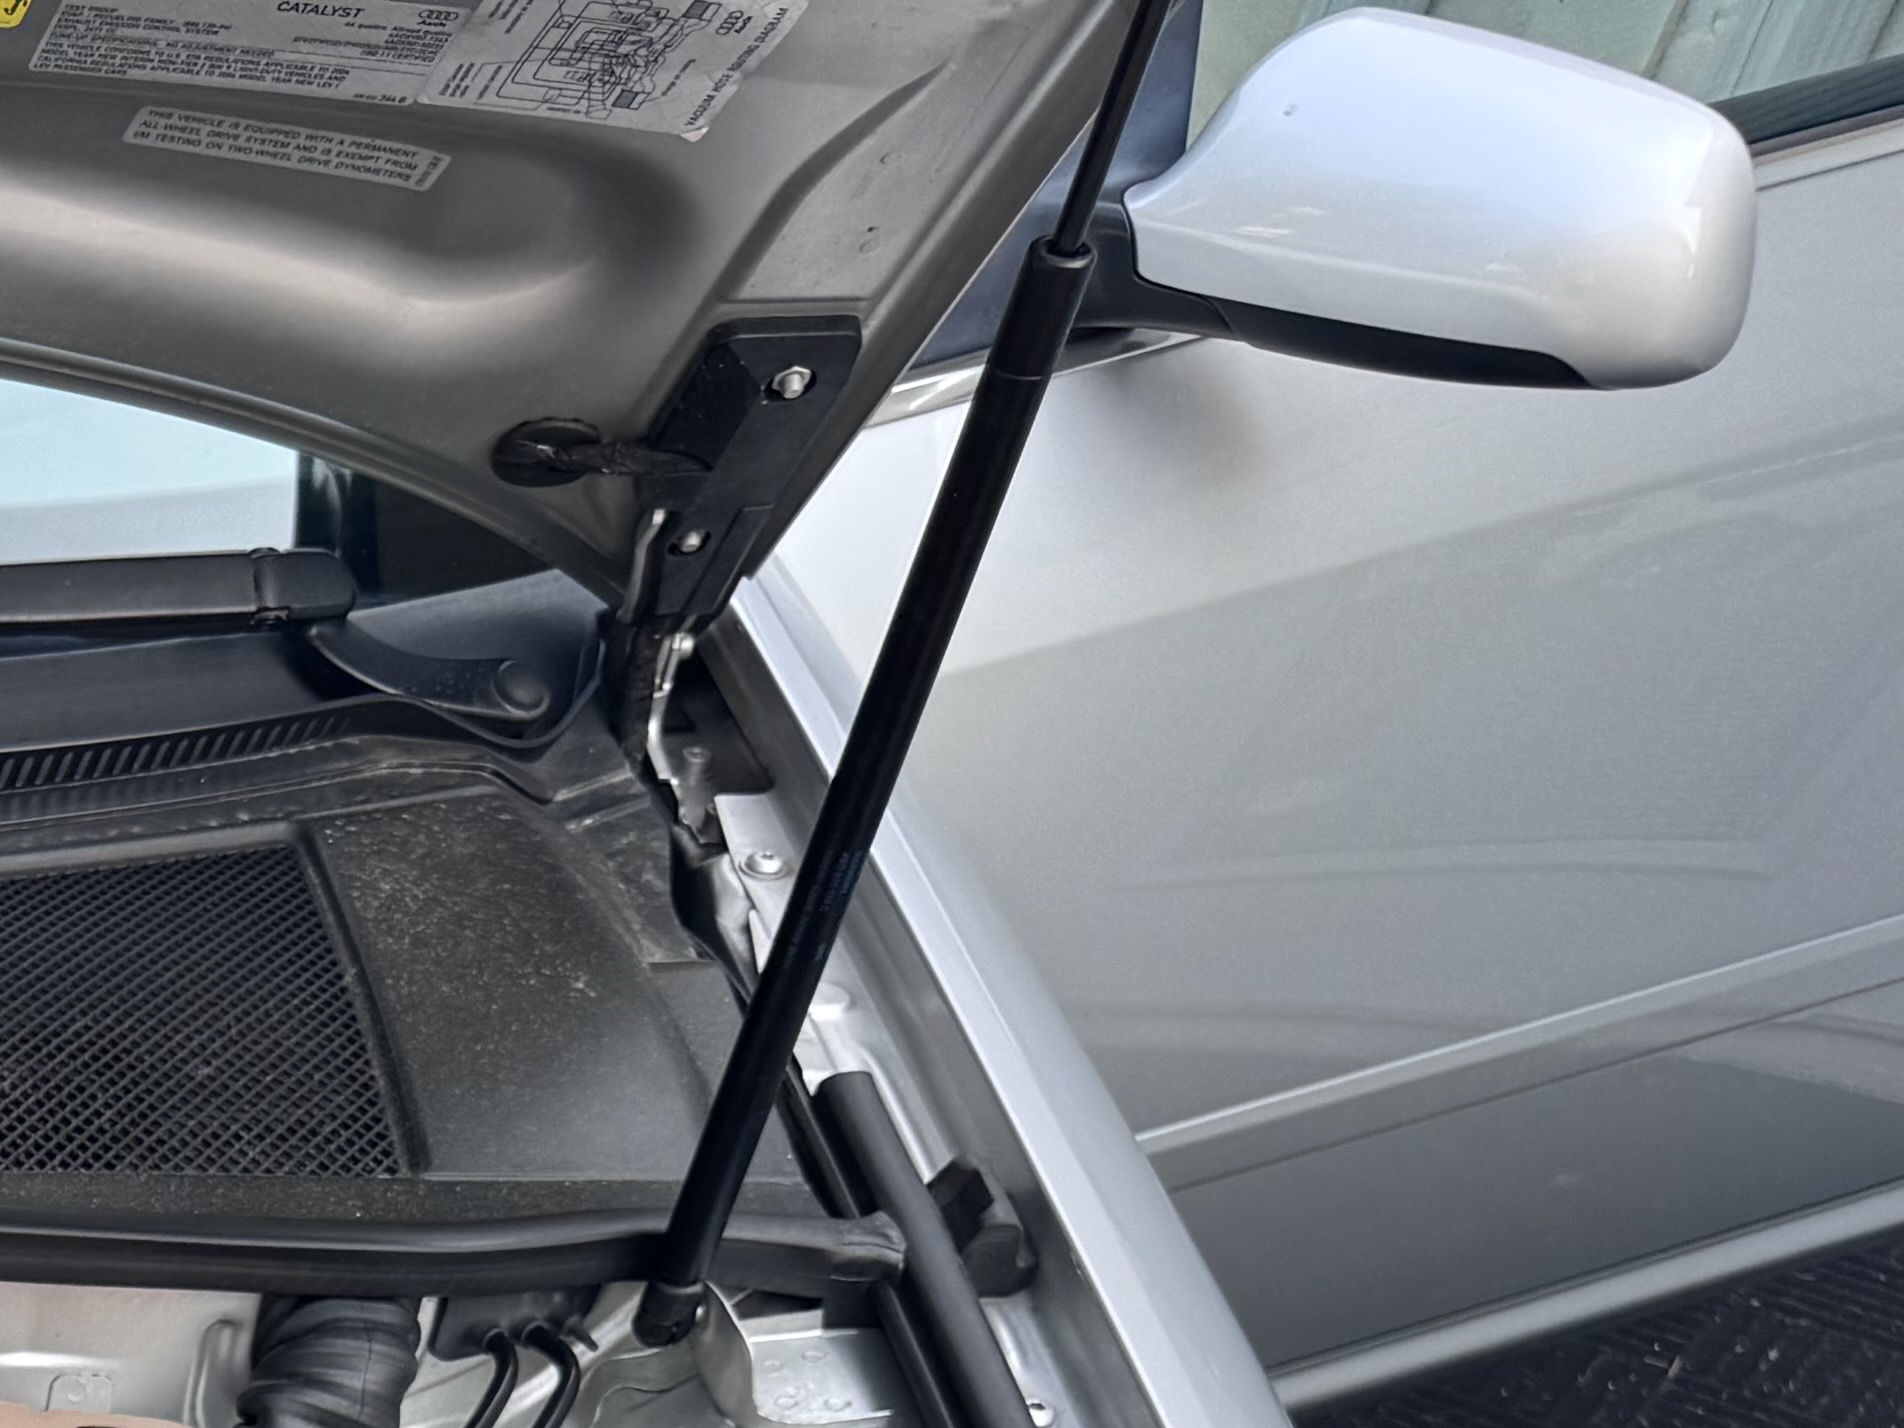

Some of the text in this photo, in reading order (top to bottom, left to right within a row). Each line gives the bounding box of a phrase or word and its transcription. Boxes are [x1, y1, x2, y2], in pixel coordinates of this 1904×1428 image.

[277, 1, 365, 19] CATALYST
[174, 112, 226, 128] VEHICLE
[241, 122, 303, 140] EQUIPPED
[346, 139, 419, 159] PERMANENT
[203, 140, 225, 151] ON
[204, 129, 242, 142] DRIVE
[242, 135, 292, 150] SYSTEM
[290, 142, 319, 154] AND
[333, 149, 382, 164] EXEMPT
[381, 157, 420, 171] FROM
